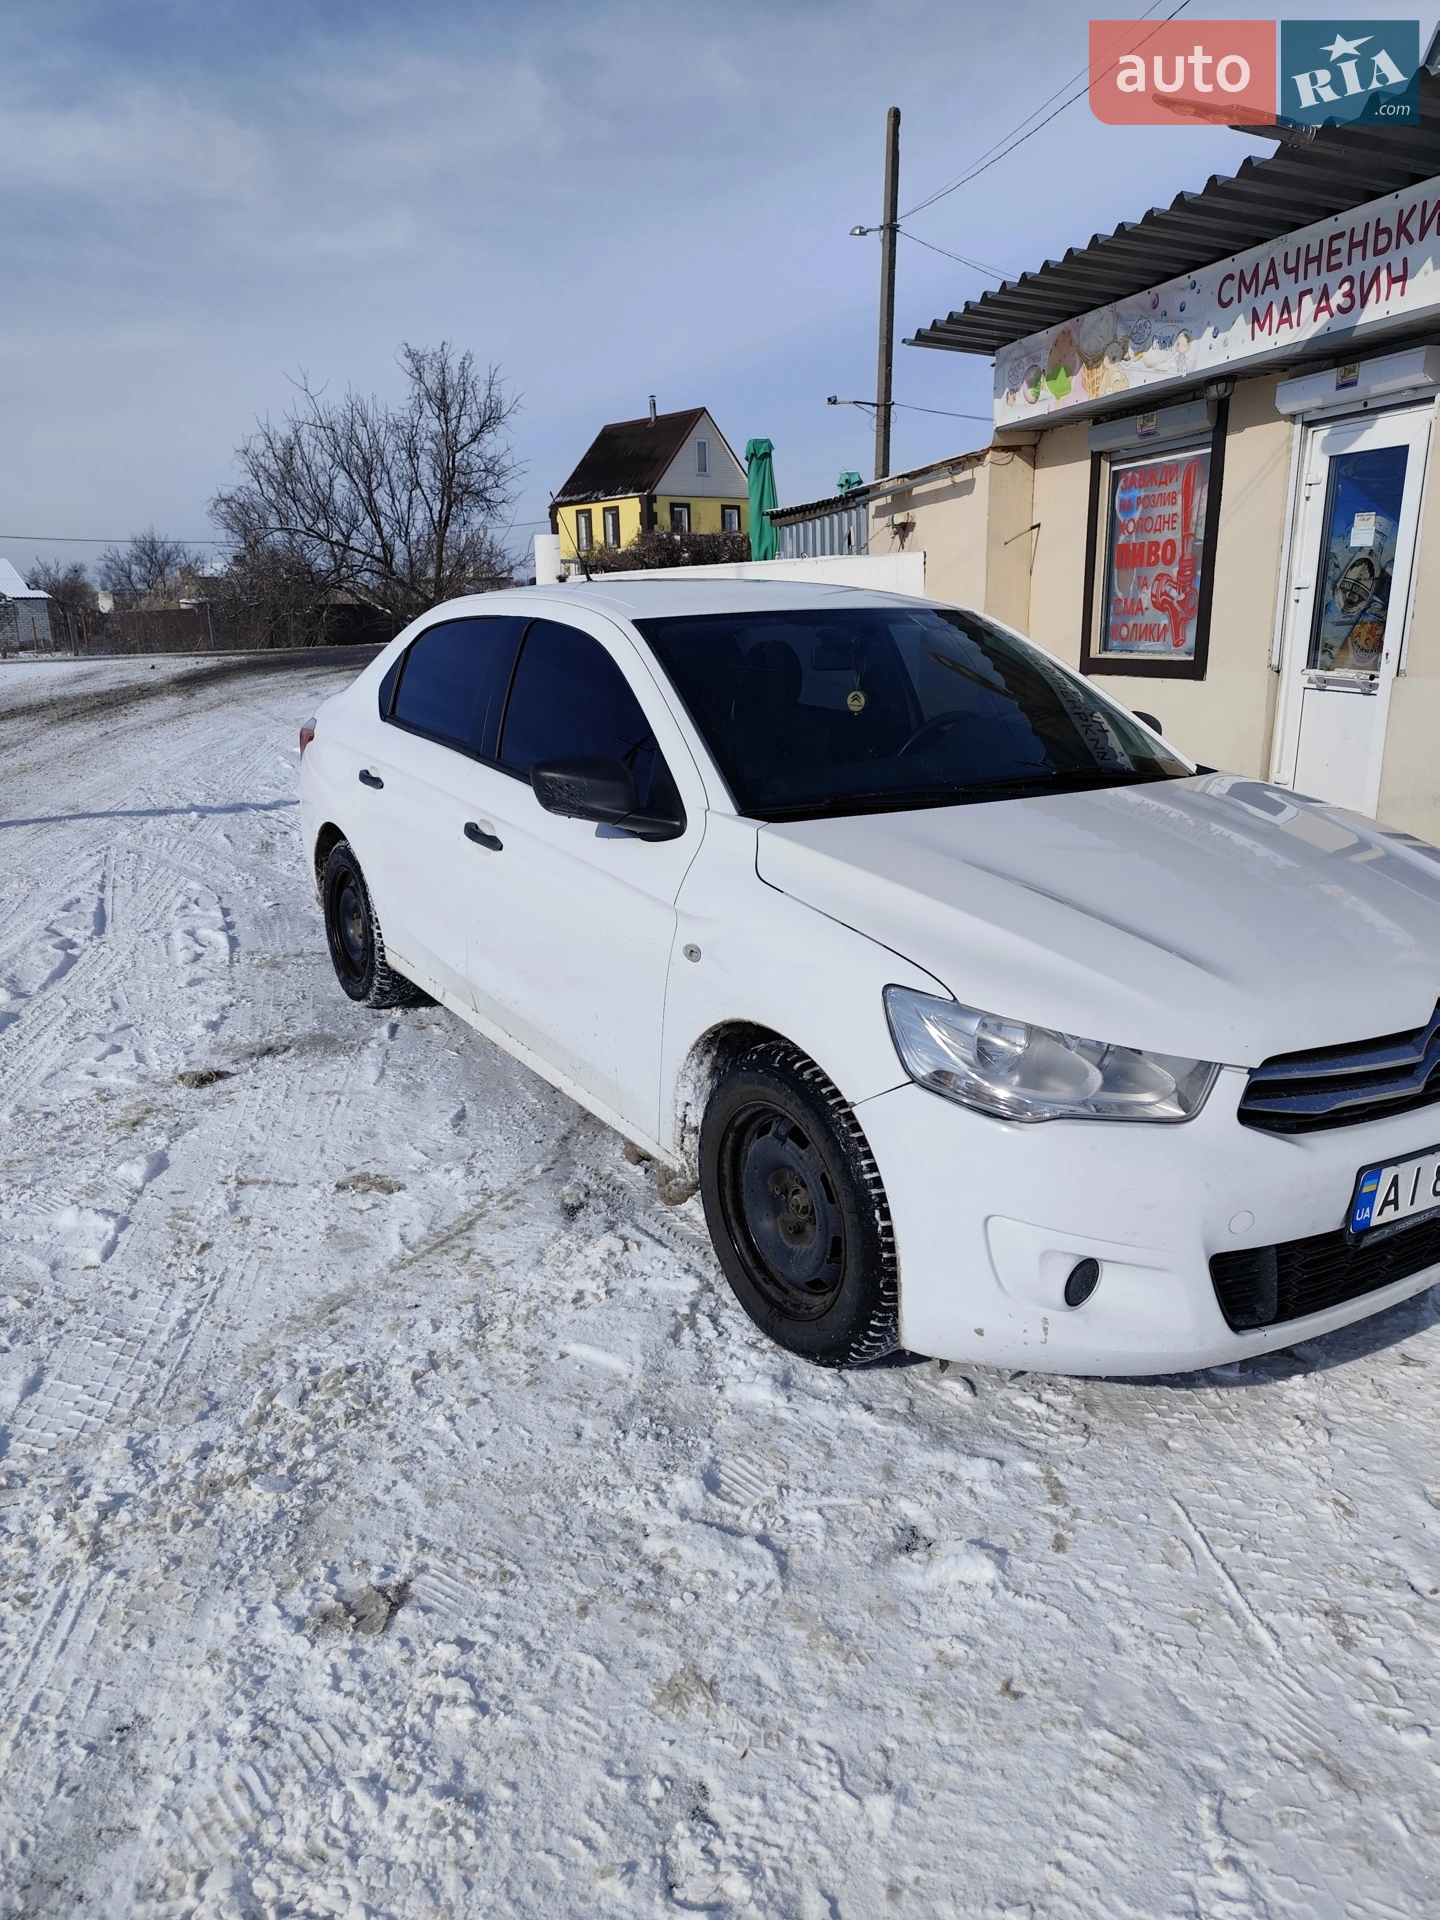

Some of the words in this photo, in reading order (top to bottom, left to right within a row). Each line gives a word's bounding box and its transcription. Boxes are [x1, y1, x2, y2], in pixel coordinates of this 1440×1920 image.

[1251, 257, 1408, 341] МАГАЗИН
[1120, 464, 1179, 491] ЗАВЖДИ
[1118, 498, 1132, 512] НА
[1136, 491, 1177, 510] РОЗЛИВ
[1119, 513, 1177, 535] ХОЛОДНЕ
[1116, 539, 1176, 569] ПИВО
[1136, 575, 1148, 590] ТА
[1113, 597, 1148, 616] СМА-
[1111, 623, 1168, 642] КОЛИКИ
[1356, 1207, 1370, 1221] UA
